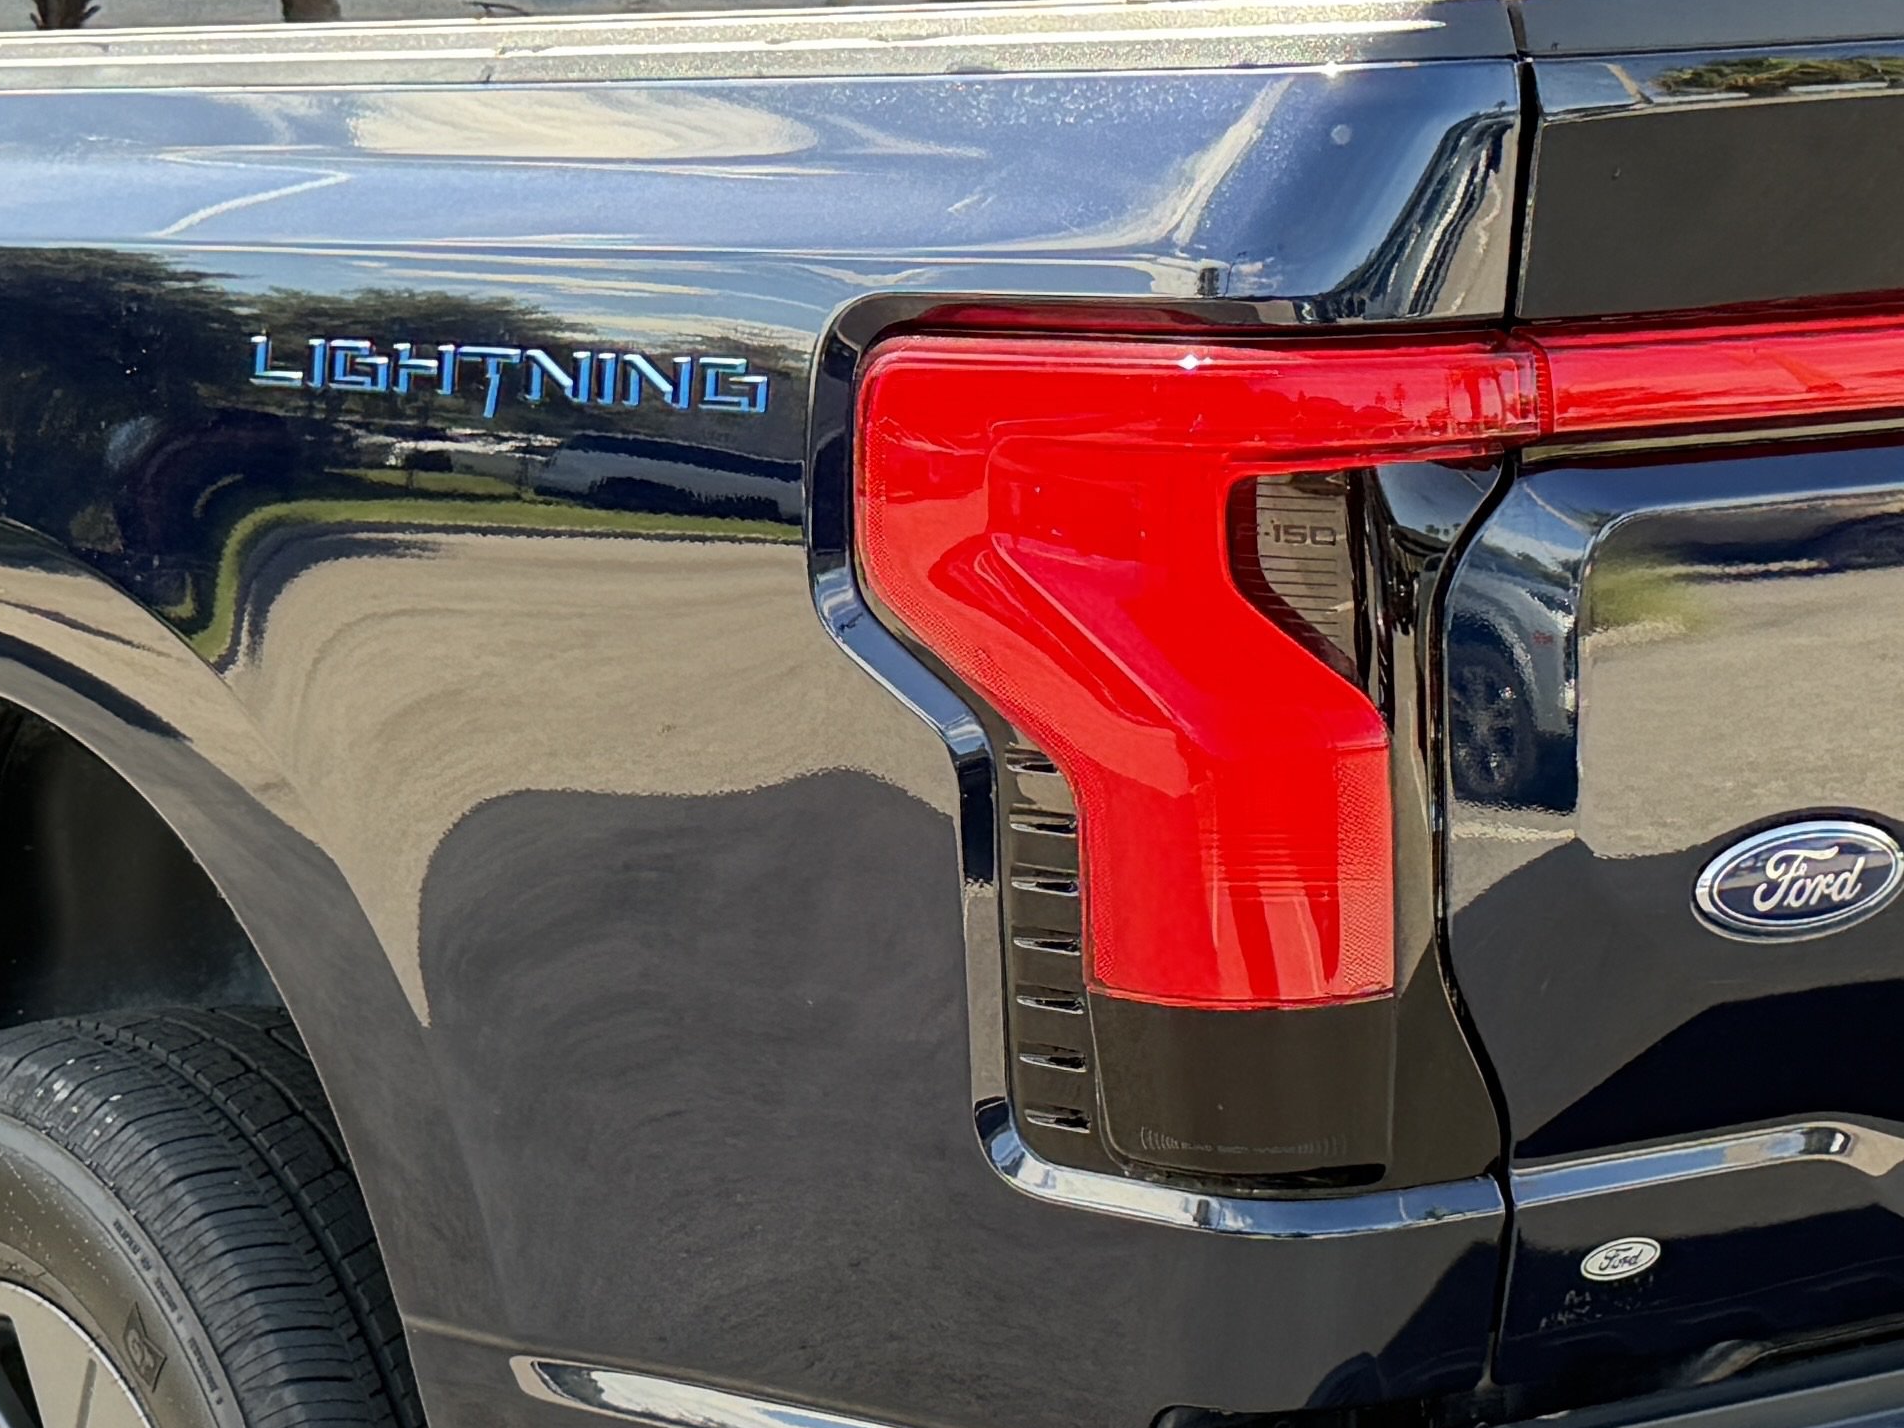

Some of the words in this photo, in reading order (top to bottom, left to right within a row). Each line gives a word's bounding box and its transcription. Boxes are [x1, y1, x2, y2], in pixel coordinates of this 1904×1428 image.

[248, 334, 769, 419] LIGHTNING
[1752, 845, 1867, 913] Ford
[1598, 1246, 1644, 1271] Ford
